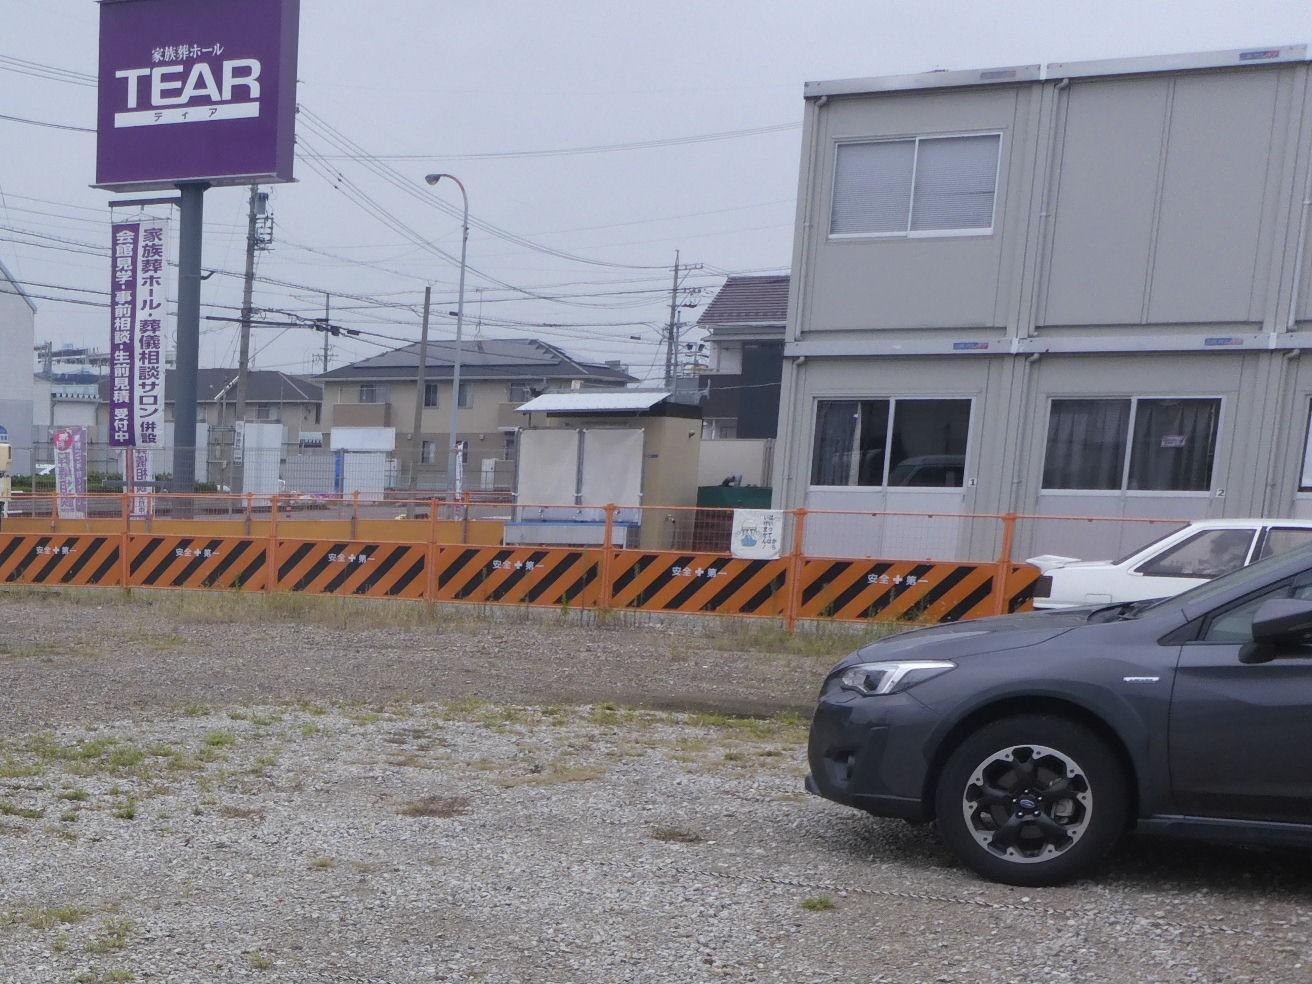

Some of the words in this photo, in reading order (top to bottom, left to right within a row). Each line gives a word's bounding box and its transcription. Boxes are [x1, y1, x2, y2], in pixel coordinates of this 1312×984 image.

[152, 44, 224, 63] 家族葬ホール
[115, 58, 261, 109] TEAR
[154, 107, 218, 122] ティア
